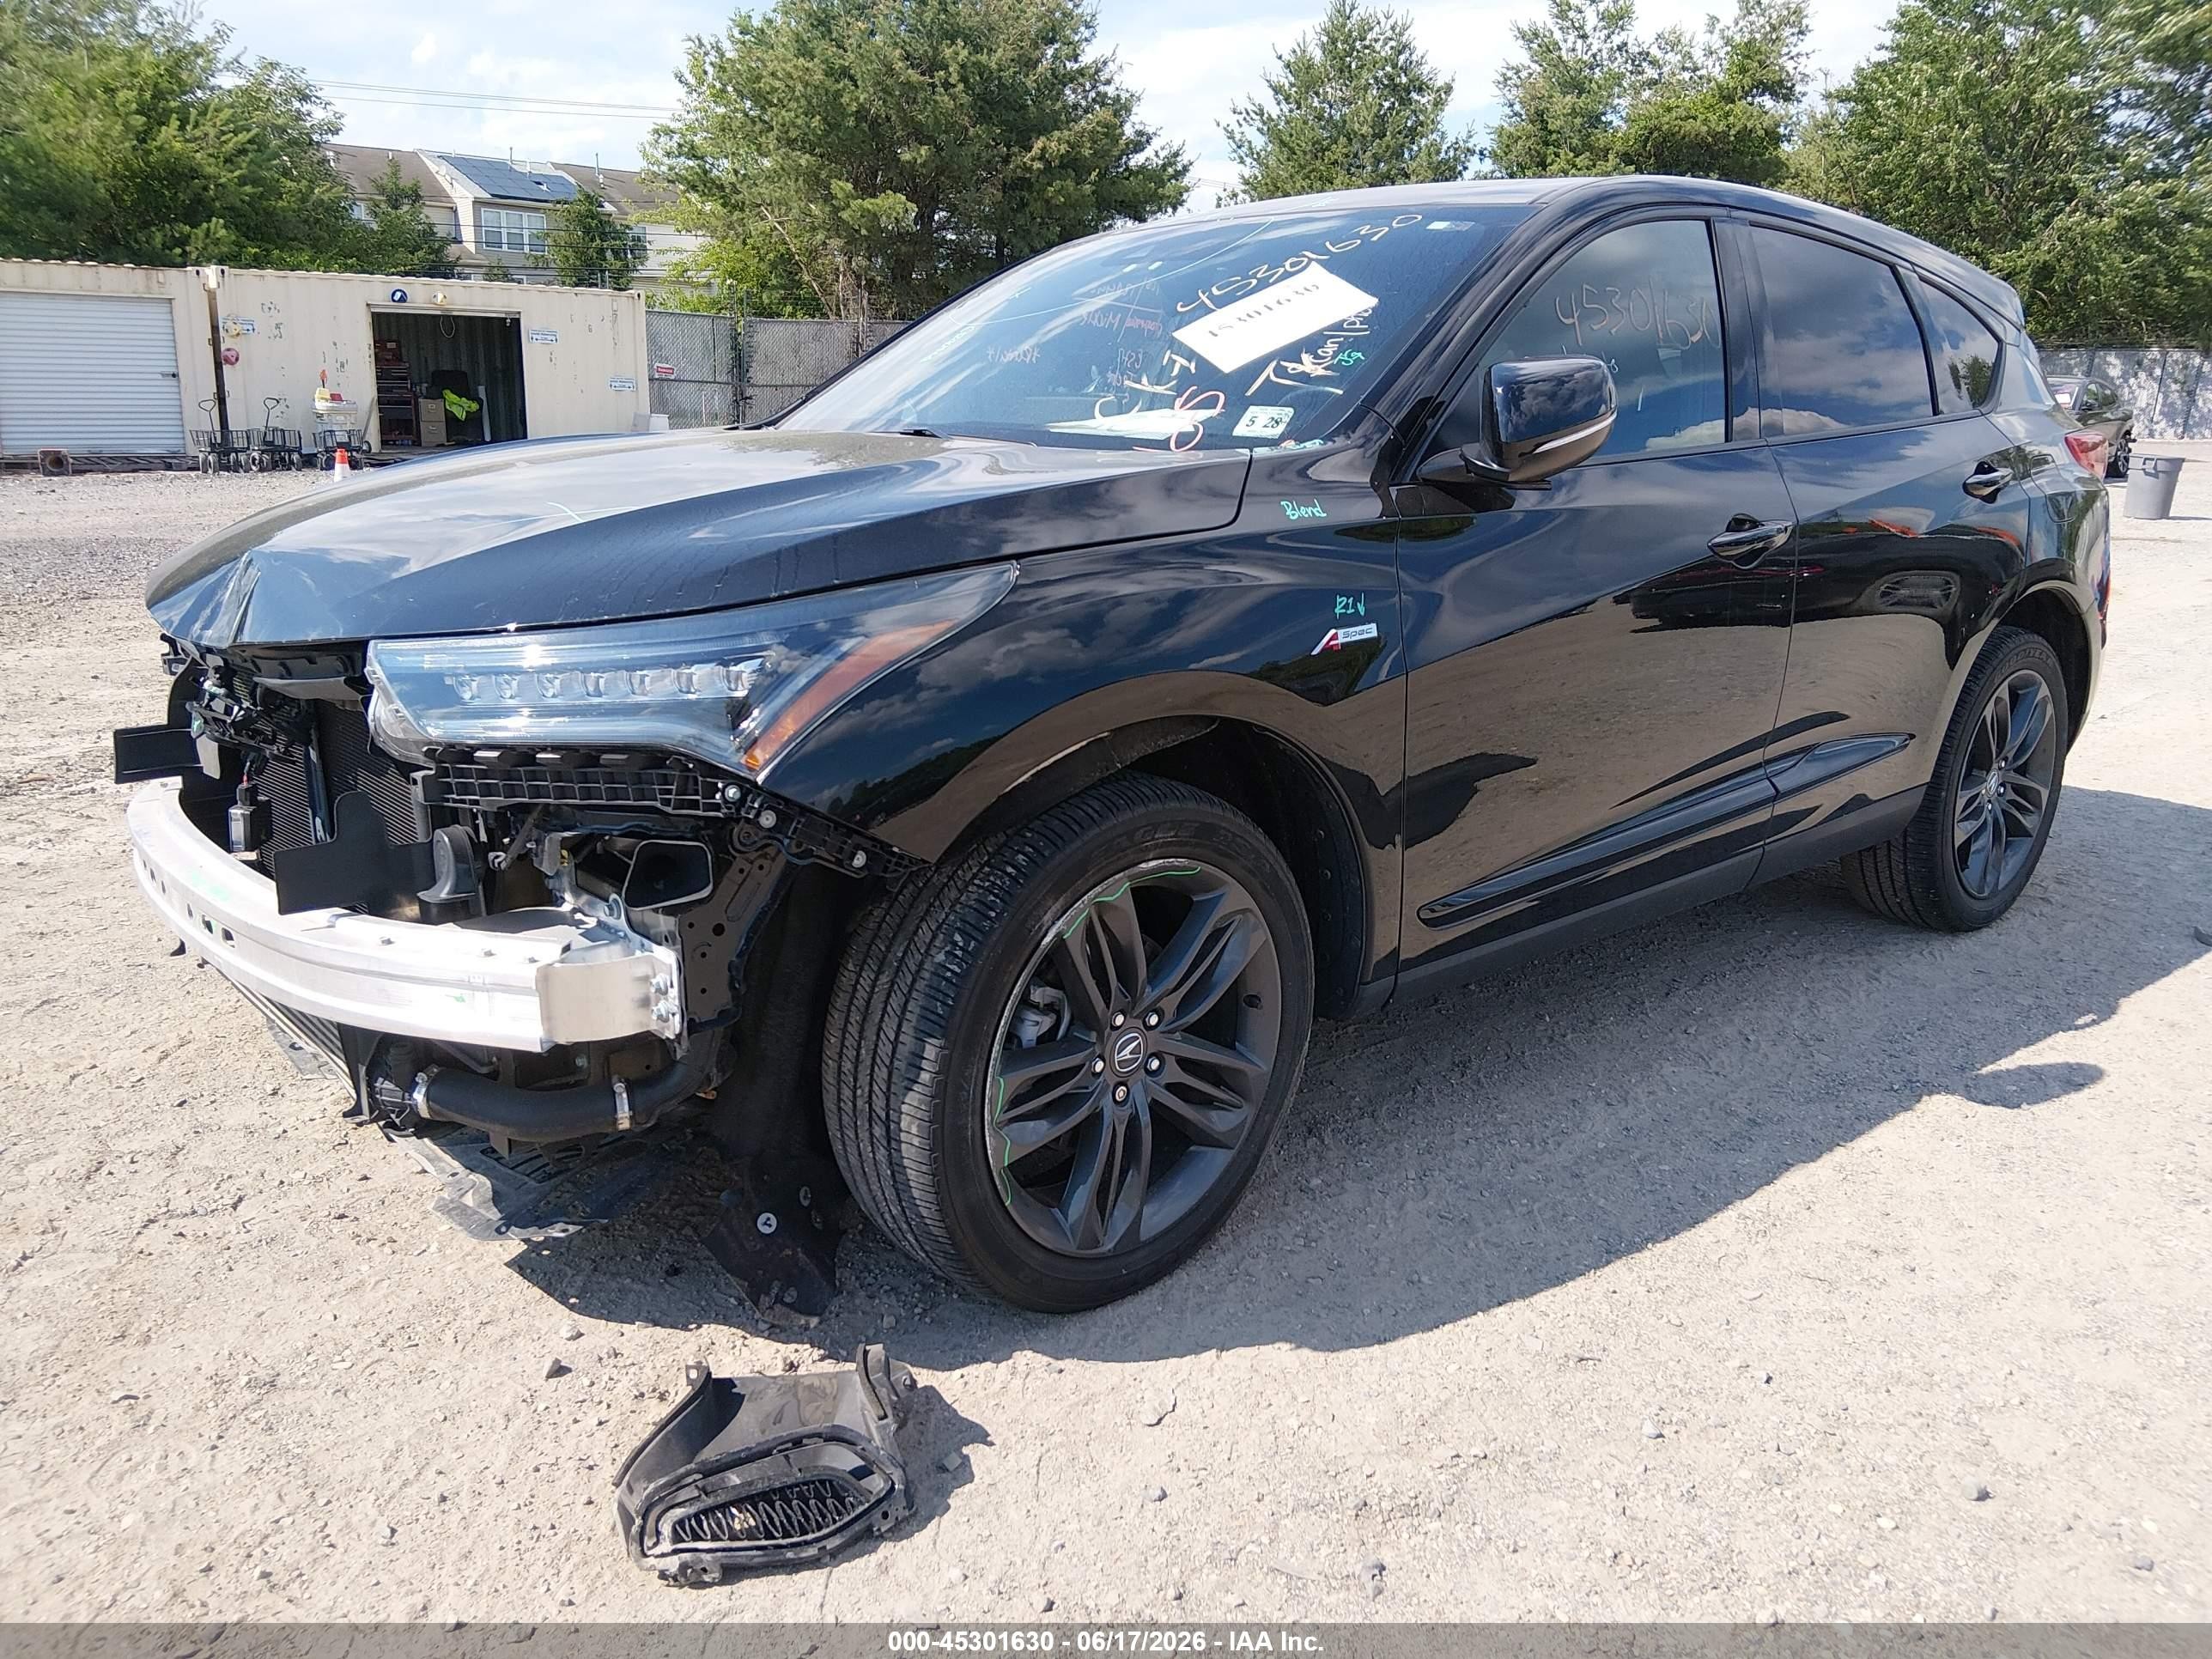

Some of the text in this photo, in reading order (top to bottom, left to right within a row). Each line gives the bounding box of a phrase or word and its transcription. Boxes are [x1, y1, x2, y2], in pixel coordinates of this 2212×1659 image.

[1245, 416, 1284, 429] 5 28
[1280, 498, 1328, 520] Blend
